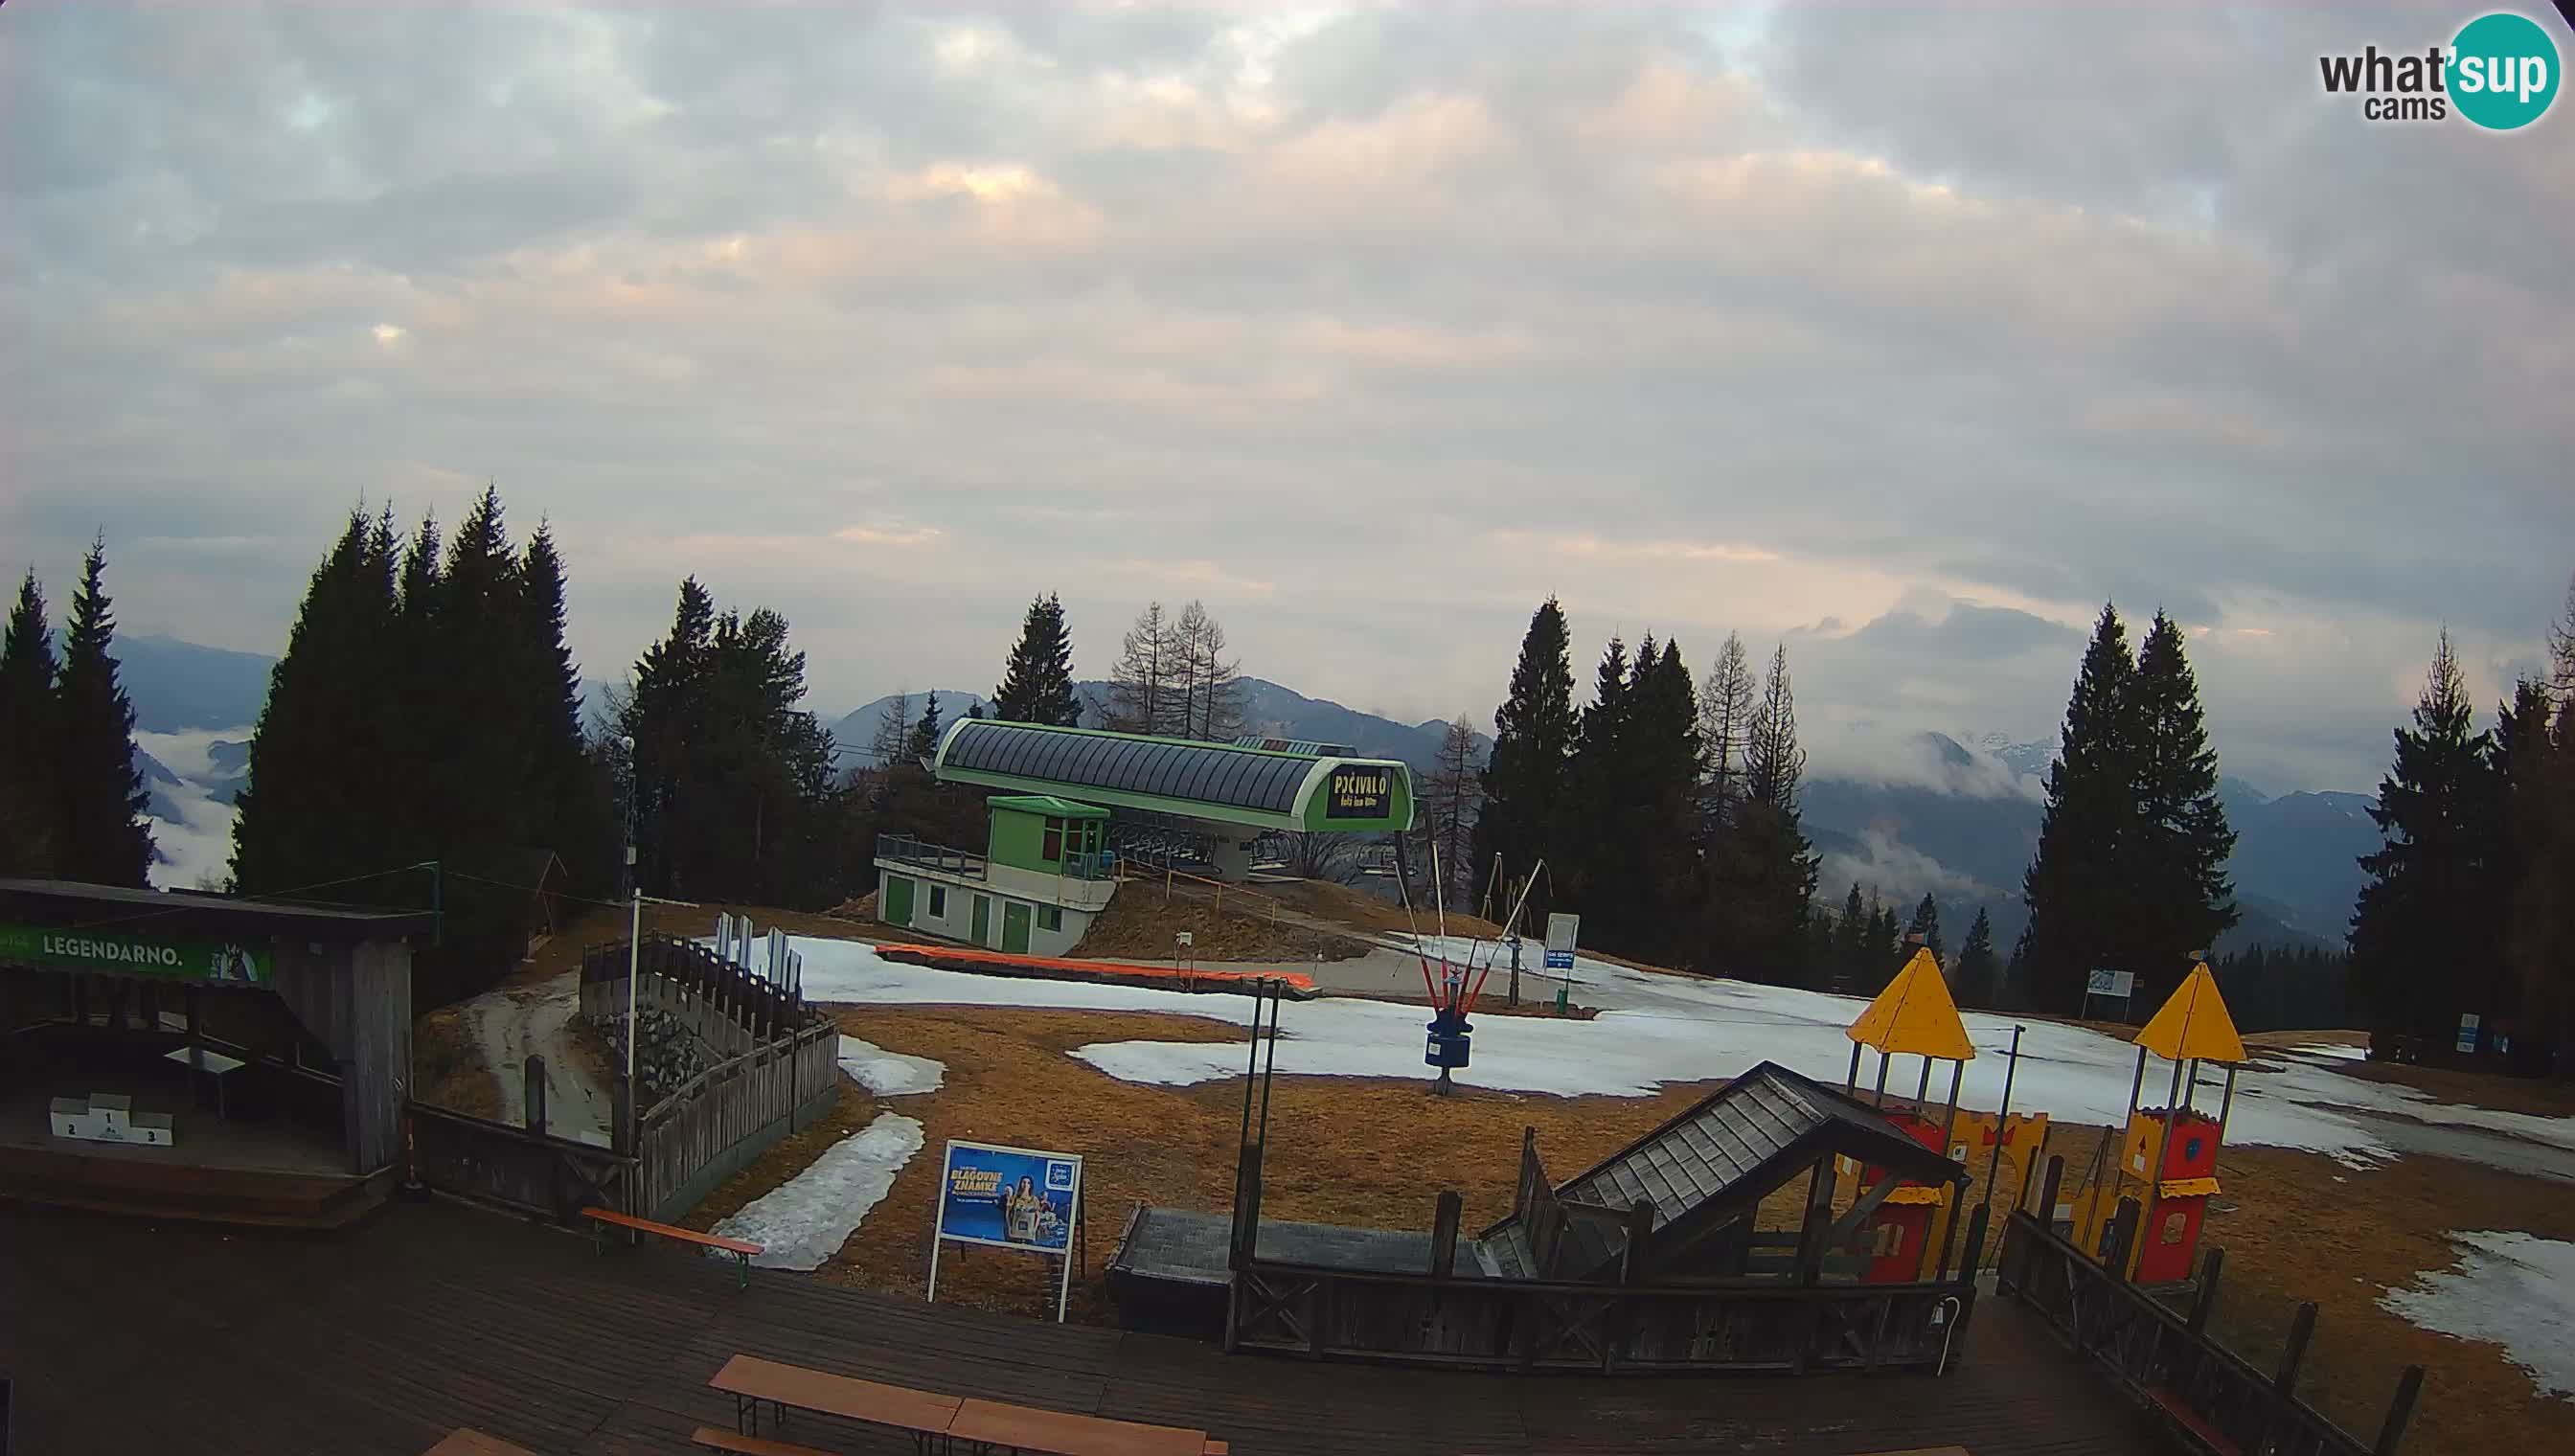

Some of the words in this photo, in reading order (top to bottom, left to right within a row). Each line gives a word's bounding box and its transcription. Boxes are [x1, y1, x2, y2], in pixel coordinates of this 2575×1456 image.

[43, 935, 184, 967] LEGENDARNO.
[68, 1124, 76, 1135] 2
[148, 1130, 155, 1142] 3
